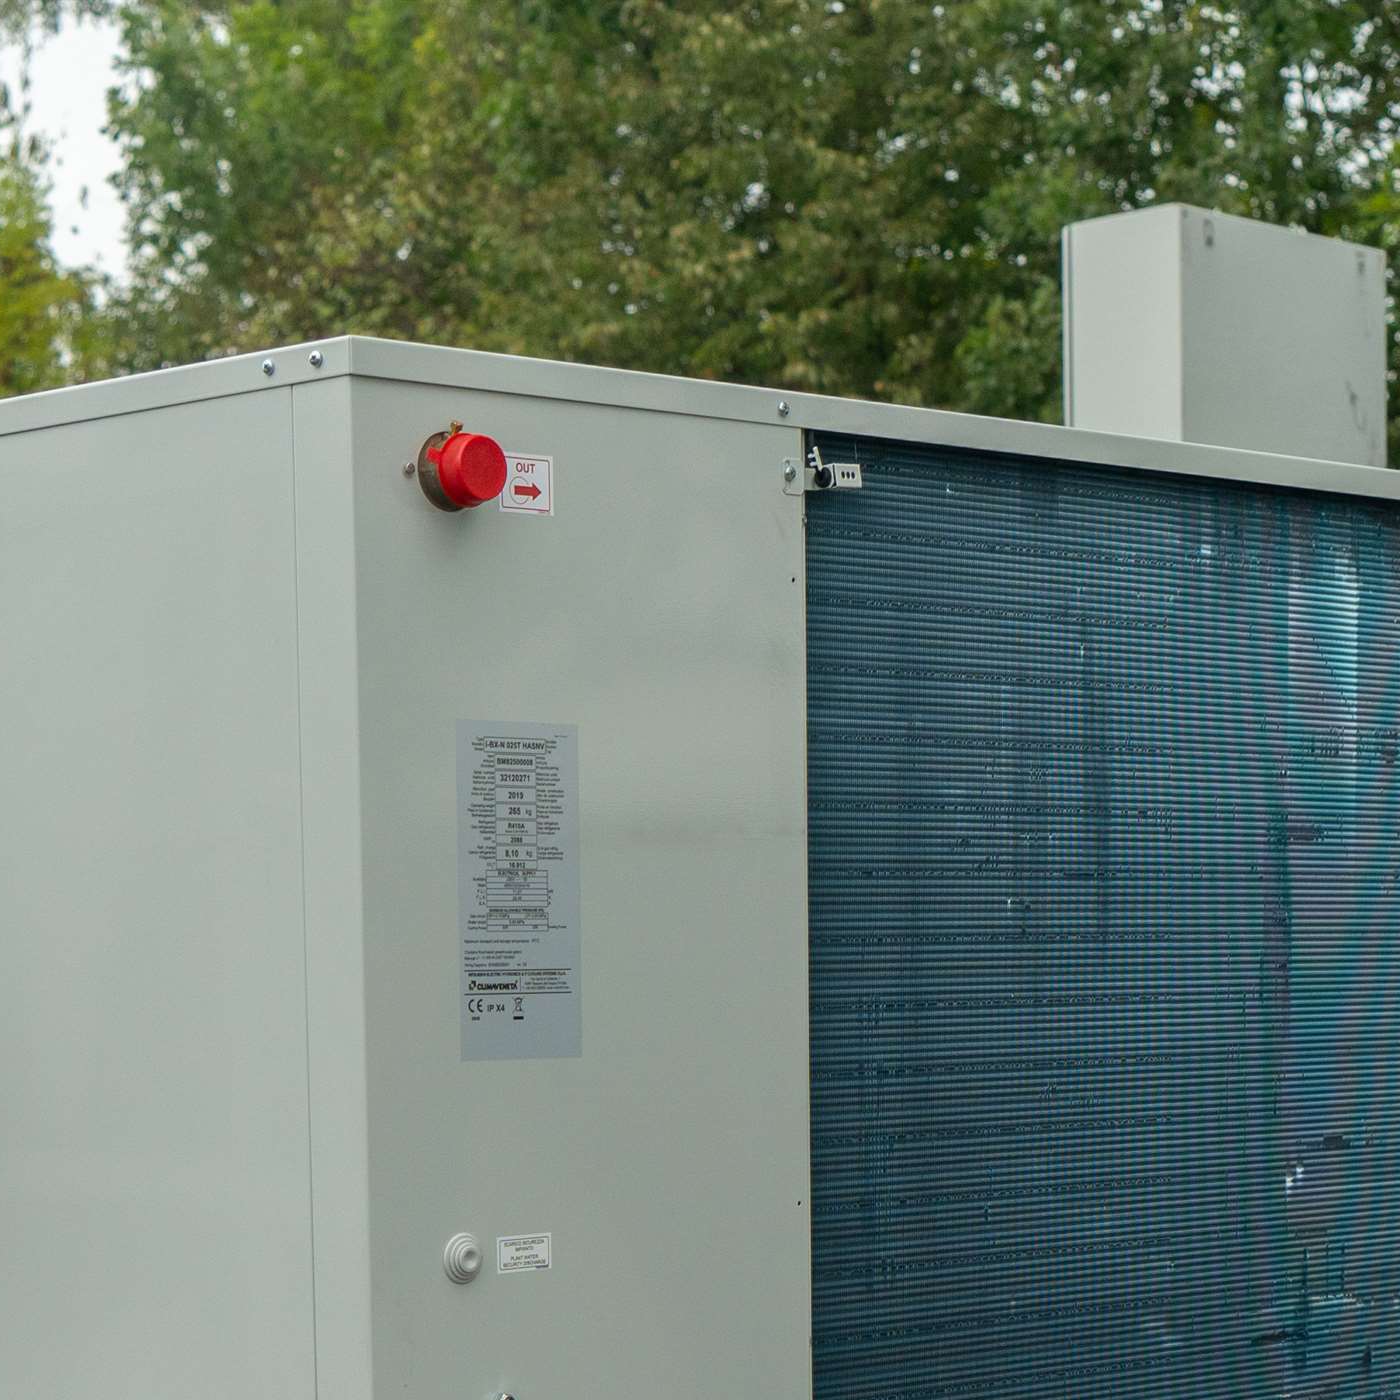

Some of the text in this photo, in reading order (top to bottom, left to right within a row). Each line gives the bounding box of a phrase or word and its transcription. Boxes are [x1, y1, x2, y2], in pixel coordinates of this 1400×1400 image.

[515, 462, 536, 474] OUT
[500, 774, 530, 782] 32120271
[508, 792, 523, 800] 2019
